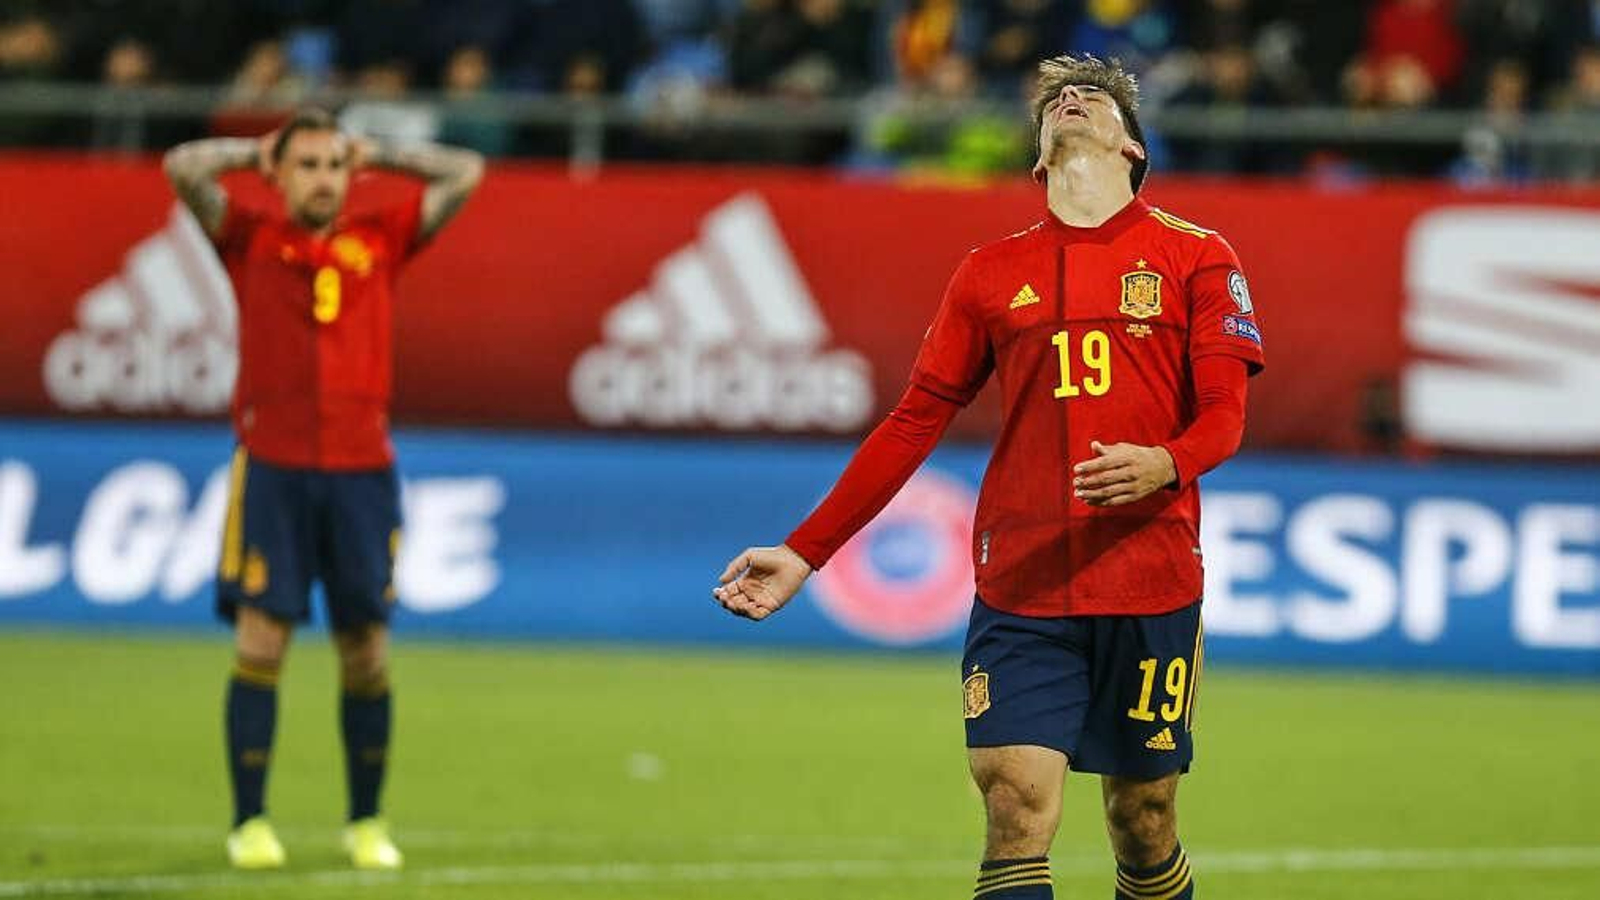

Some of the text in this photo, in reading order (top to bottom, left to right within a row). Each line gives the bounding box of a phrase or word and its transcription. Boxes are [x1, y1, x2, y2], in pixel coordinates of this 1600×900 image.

[314, 266, 342, 323] 9
[569, 346, 875, 428] adidas
[1052, 330, 1111, 398] 19
[1128, 657, 1187, 722] 19
